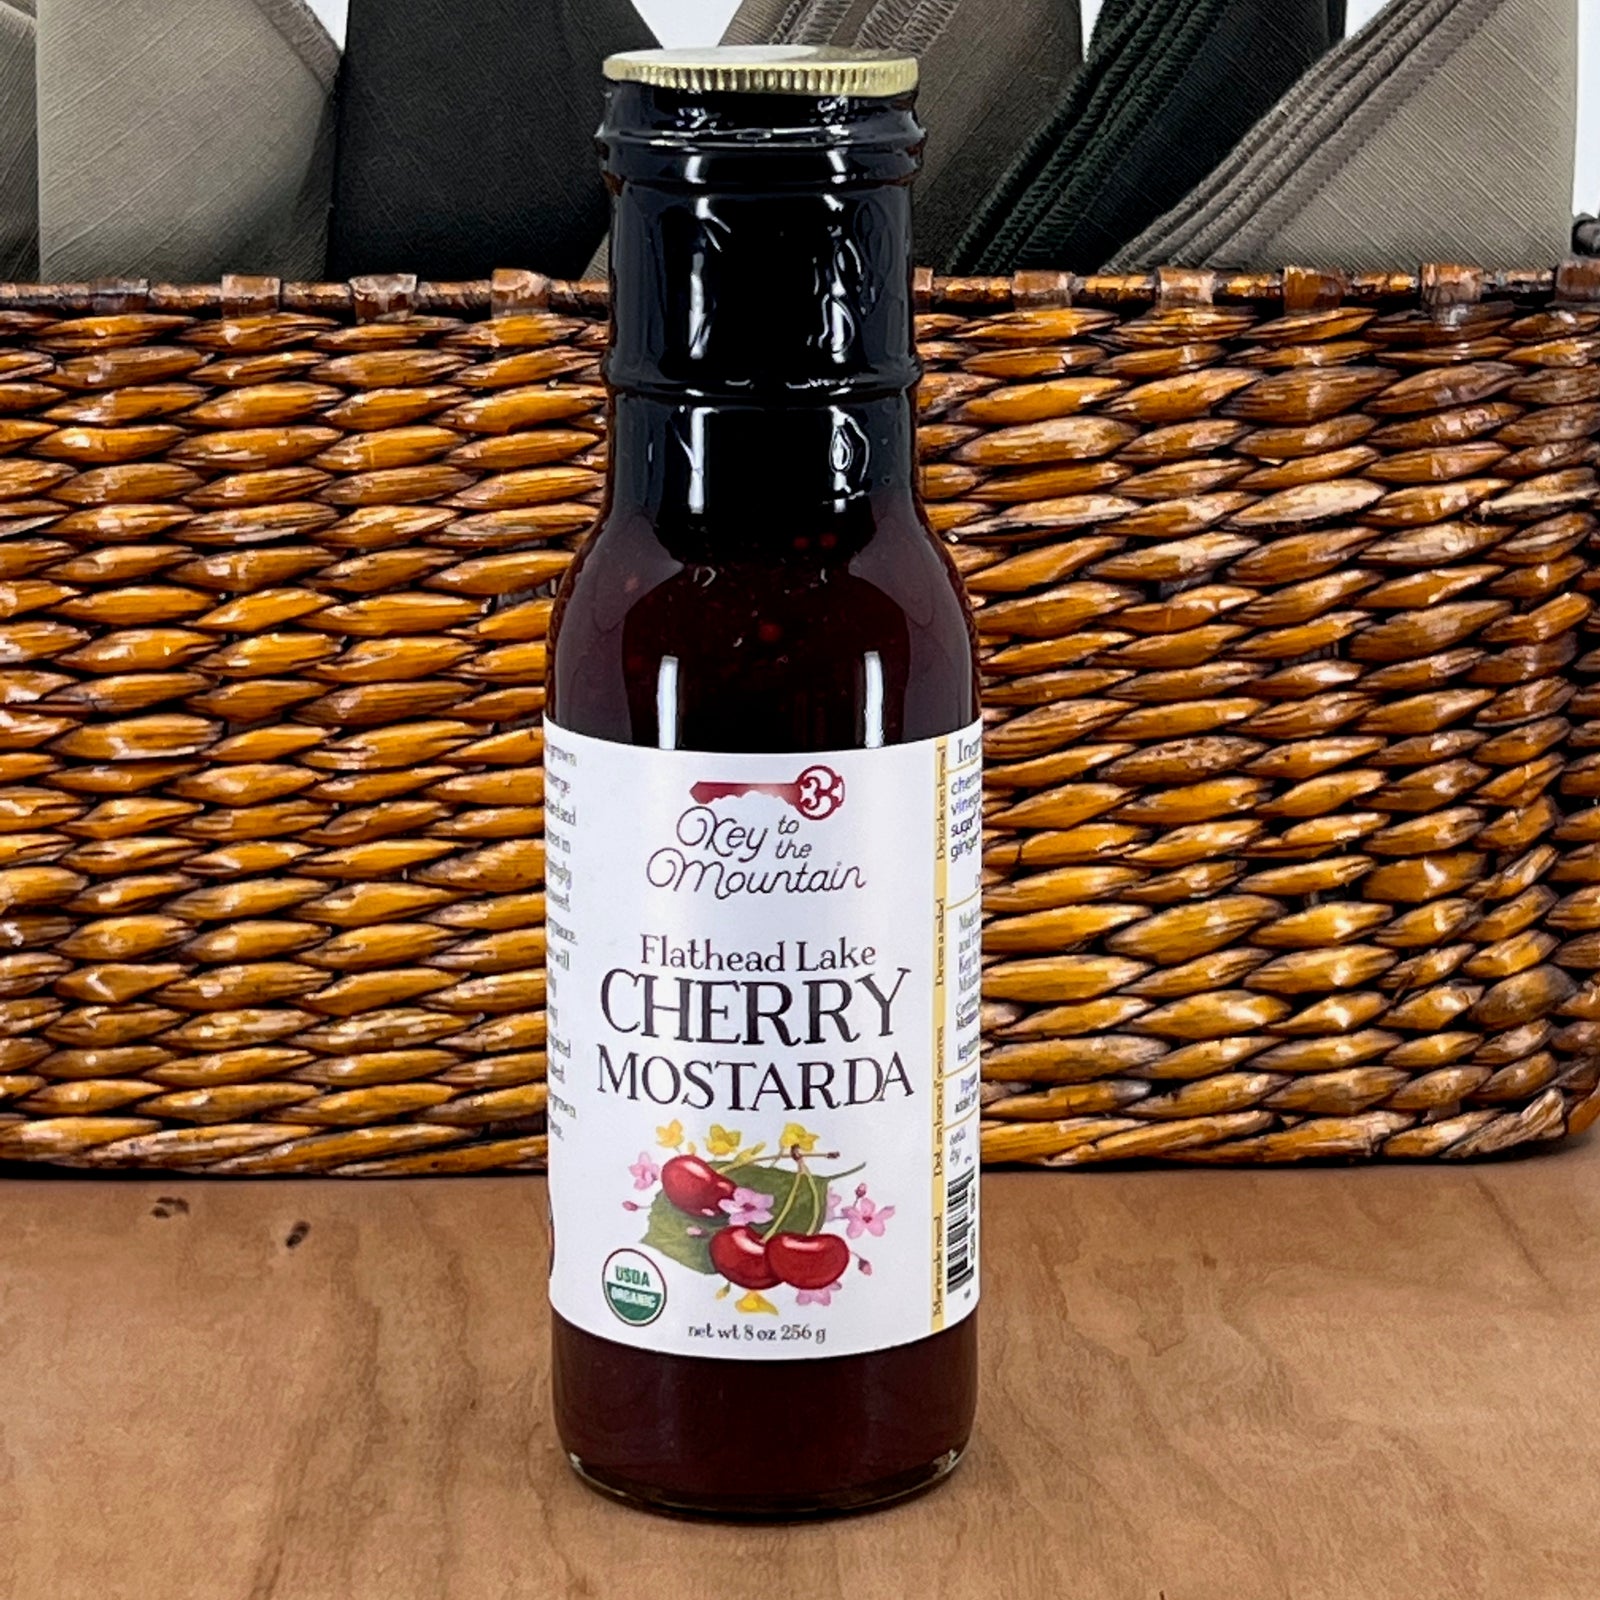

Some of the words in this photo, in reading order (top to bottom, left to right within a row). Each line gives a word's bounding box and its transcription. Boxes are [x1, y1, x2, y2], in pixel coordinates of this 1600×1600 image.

[676, 806, 768, 862] Key
[778, 815, 800, 834] to
[775, 839, 812, 858] the
[646, 847, 867, 900] Mountain
[640, 934, 785, 972] Flathead
[796, 936, 877, 972] Lake
[600, 967, 911, 1046] CHERRY
[596, 1043, 914, 1111] MOSTARDA
[614, 1265, 651, 1288] USDA
[609, 1287, 657, 1309] ORGANIC
[688, 1323, 714, 1339] net
[717, 1324, 739, 1340] wt
[744, 1324, 754, 1340] 8
[756, 1330, 777, 1341] oz
[780, 1324, 812, 1341] 256
[815, 1327, 827, 1344] g
